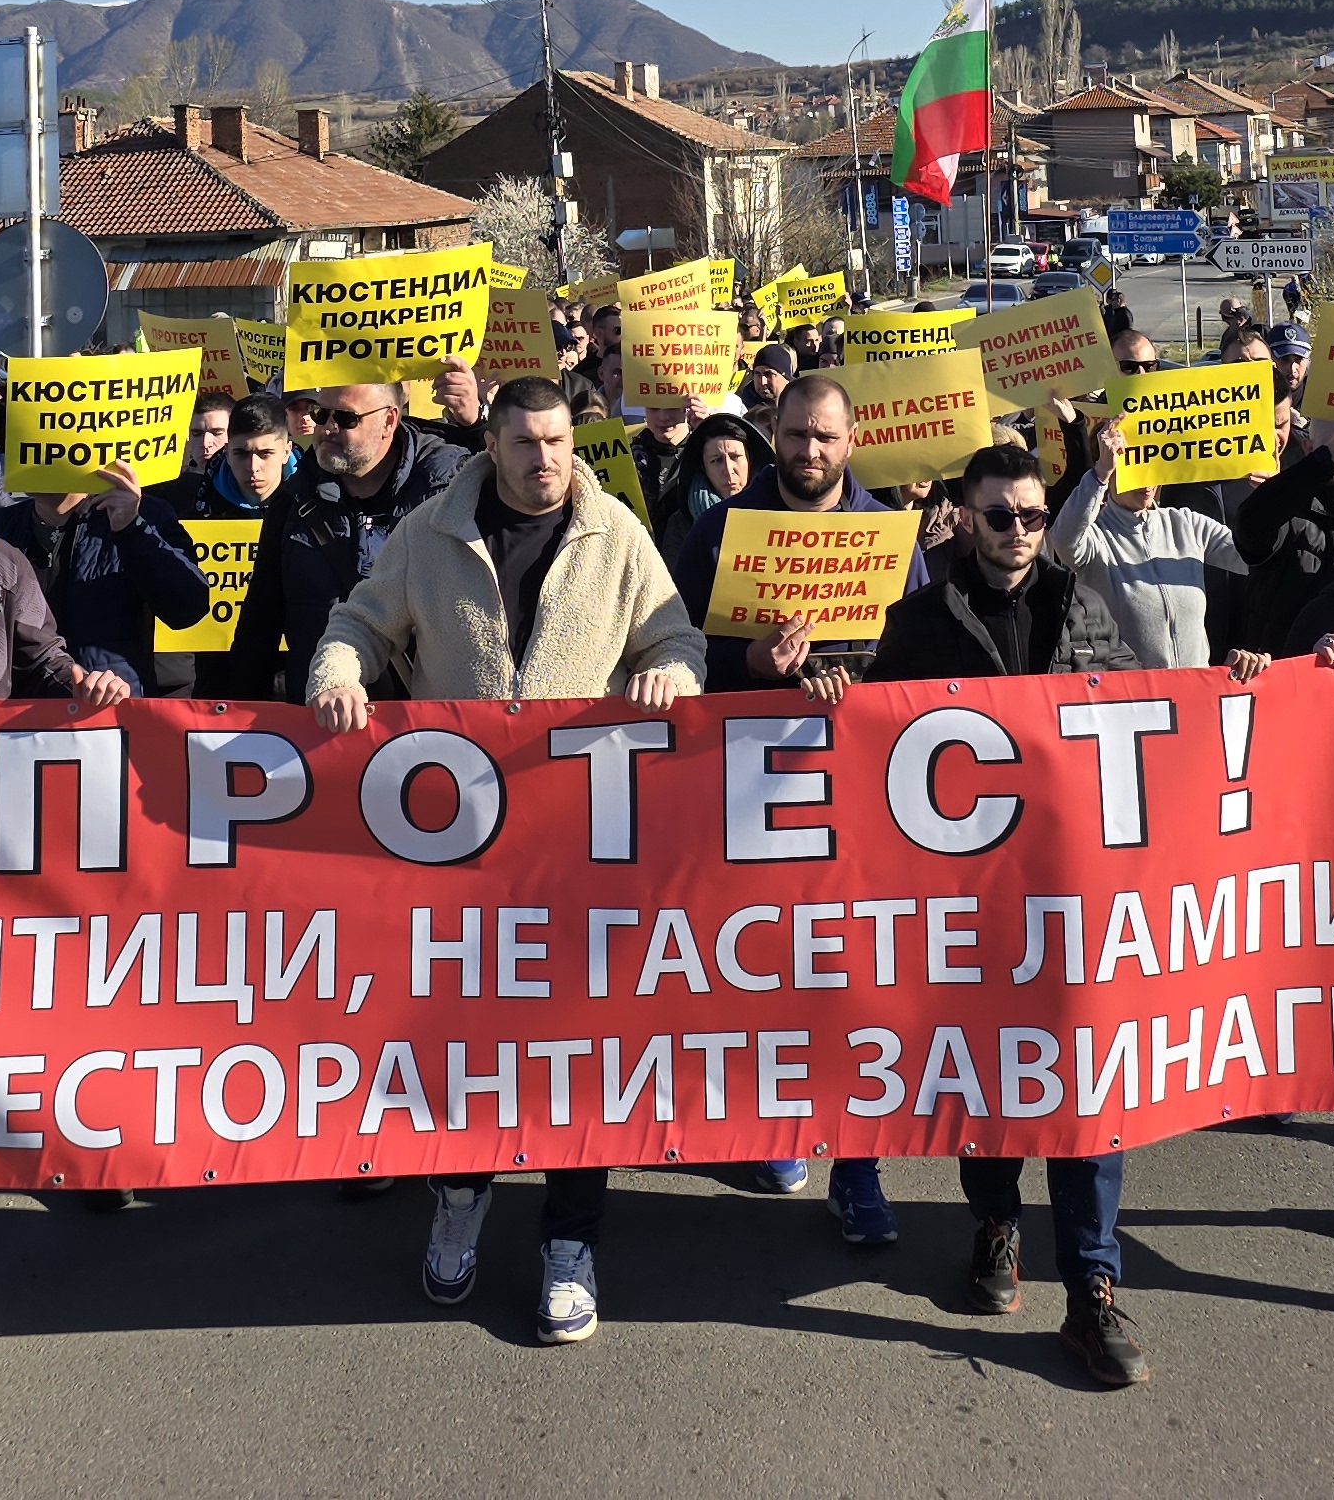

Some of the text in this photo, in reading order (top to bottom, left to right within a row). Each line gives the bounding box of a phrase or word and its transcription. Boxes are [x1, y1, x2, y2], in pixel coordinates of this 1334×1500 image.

[1133, 243, 1157, 252] Sofia
[1226, 243, 1307, 256] кв. Ораново
[1226, 257, 1305, 268] kv. Oranovo
[292, 266, 488, 304] КЮСТЕНДИЛ
[641, 272, 694, 296] ПРОТЕСТ
[649, 283, 707, 308] УБИВАЙТЕ
[788, 283, 835, 297] БАНСКО
[320, 301, 463, 330] ПОДКРЕПЯ
[784, 302, 844, 319] ПРОТЕСТА
[151, 328, 207, 345] ПРОТЕСТ
[238, 328, 285, 347] КЮСТЕН
[652, 324, 720, 337] ПРОТЕСТ
[847, 327, 955, 344] КЮСТЕНД
[979, 314, 1080, 353] ПОЛИТИЦИ
[247, 345, 285, 360] ПОДКРЕ
[300, 328, 475, 362] ПРОТЕСТА
[632, 344, 655, 357] НЕ
[661, 341, 730, 357] УБИВАЙТЕ
[1001, 331, 1098, 368] УБИВАЙТЕ
[651, 363, 718, 376] ТУРИЗМА
[997, 356, 1085, 389] ТУРИЗМА
[11, 372, 196, 402] КЮСТЕНДИЛ
[639, 382, 650, 394] В
[1122, 384, 1260, 413] САНДАНСКИ
[854, 390, 976, 422] НИ ГАСЕТЕ
[39, 405, 173, 433] ПОДКРЕПЯ
[1138, 409, 1250, 435] ПОДКРЕПЯ
[19, 433, 178, 466] ПРОТЕСТА
[1124, 433, 1266, 466] ПРОТЕСТА
[767, 529, 880, 548] ПРОТЕСТ
[733, 552, 899, 575] НЕ УБИВАЙТЕ
[755, 580, 867, 601] ТУРИЗМА
[730, 606, 748, 622] В
[411, 907, 551, 998] НЕ
[587, 896, 982, 998] ГАСЕТЕ
